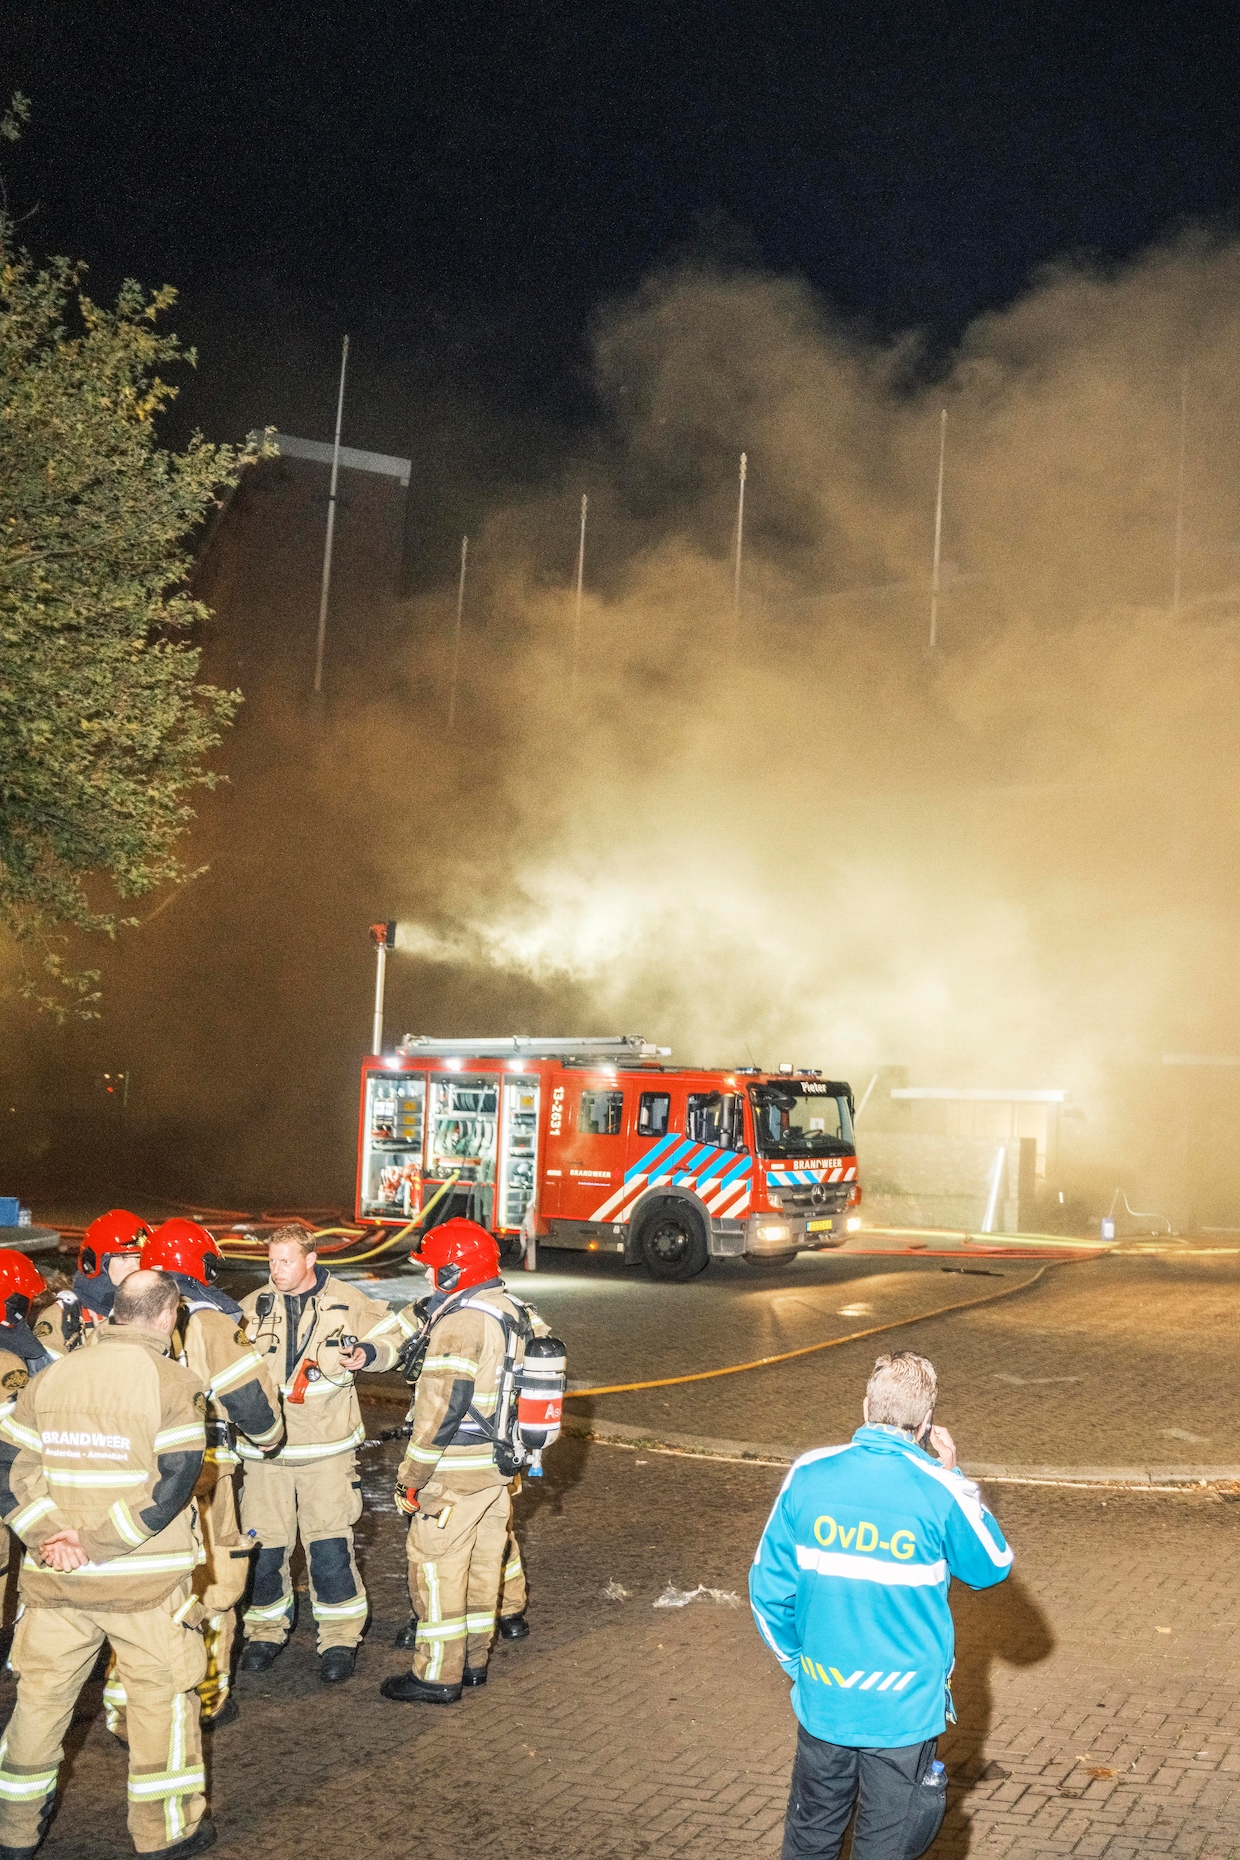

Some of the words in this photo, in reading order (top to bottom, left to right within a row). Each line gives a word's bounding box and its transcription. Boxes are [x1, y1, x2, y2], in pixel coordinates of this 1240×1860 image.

[800, 1081, 827, 1093] Pieter
[549, 1086, 564, 1136] 13-2631
[793, 1159, 842, 1170] BRANDWEER
[569, 1169, 611, 1178] BRANDWEER
[42, 1431, 130, 1450] BRANDWEER
[813, 1515, 916, 1560] OvD-G
